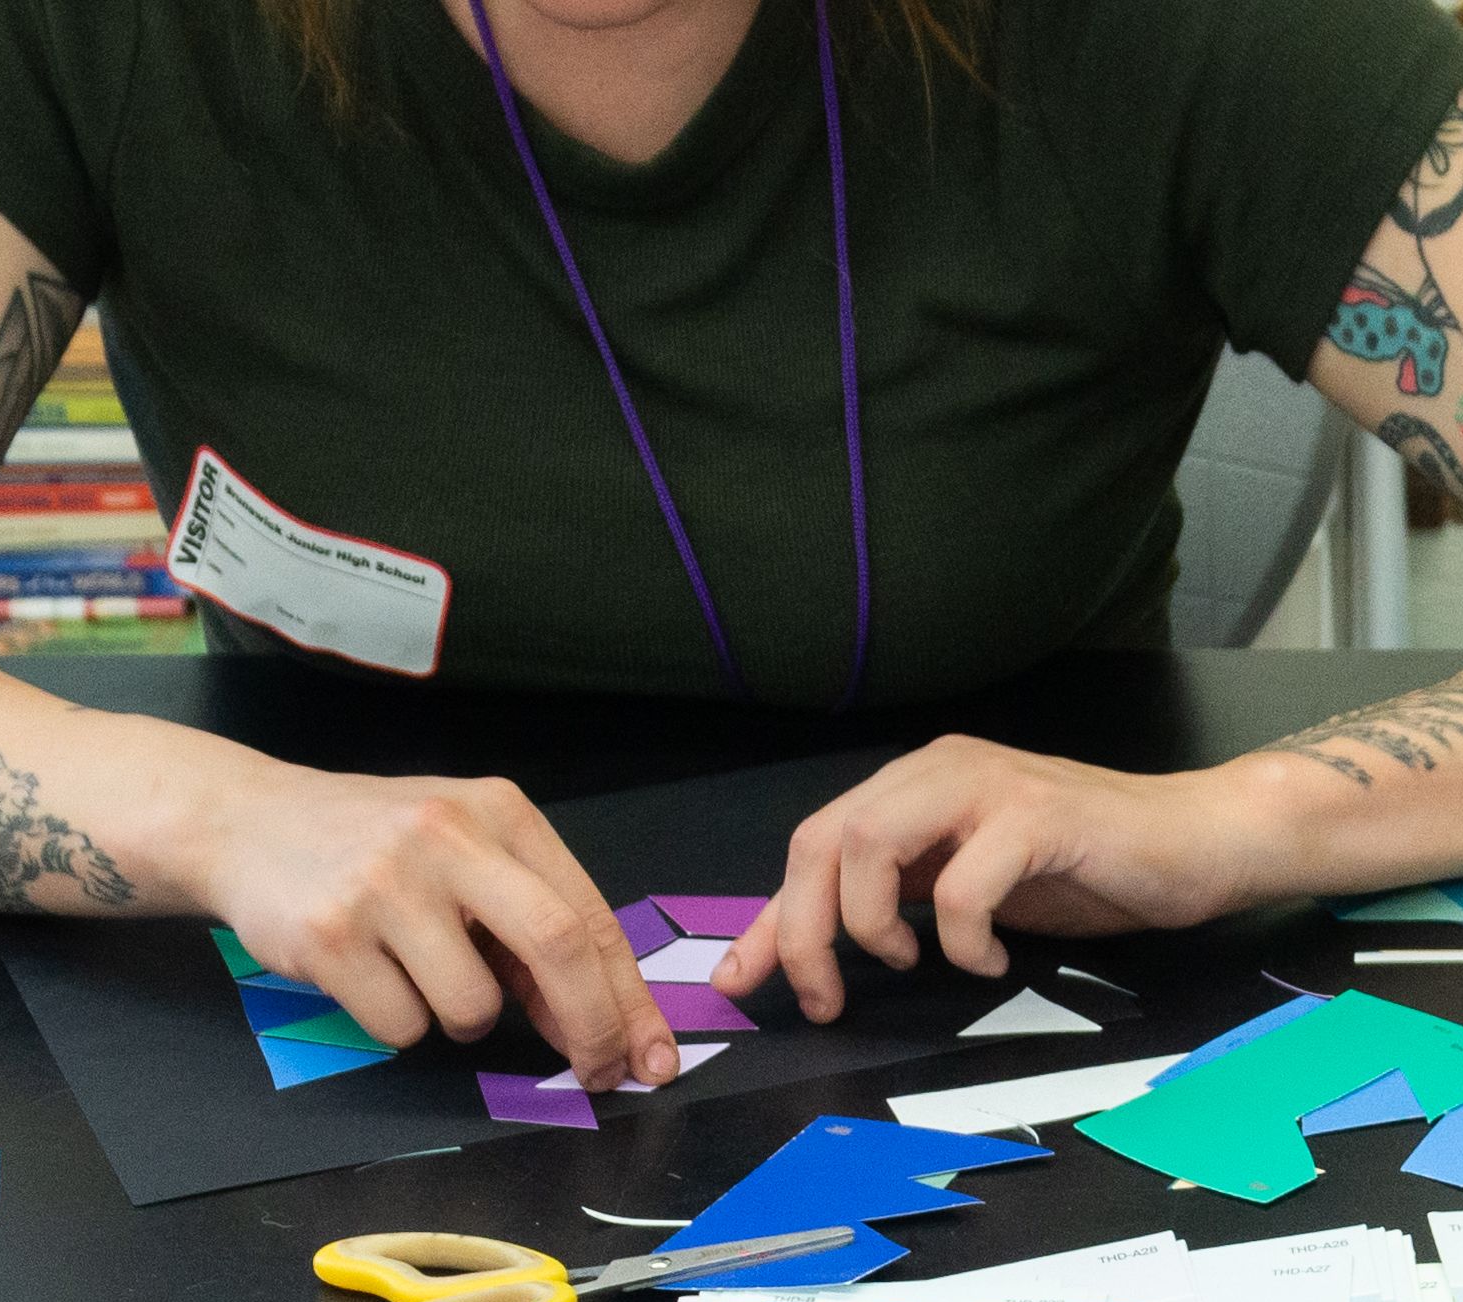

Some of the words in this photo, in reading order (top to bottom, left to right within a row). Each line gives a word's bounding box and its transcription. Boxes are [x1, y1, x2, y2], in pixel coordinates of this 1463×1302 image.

[176, 460, 218, 564] VISITOR
[225, 485, 283, 536] Brunswick
[286, 533, 332, 557] Junior
[336, 550, 370, 569] High
[375, 561, 426, 586] School
[1273, 1264, 1331, 1278] THD-A27
